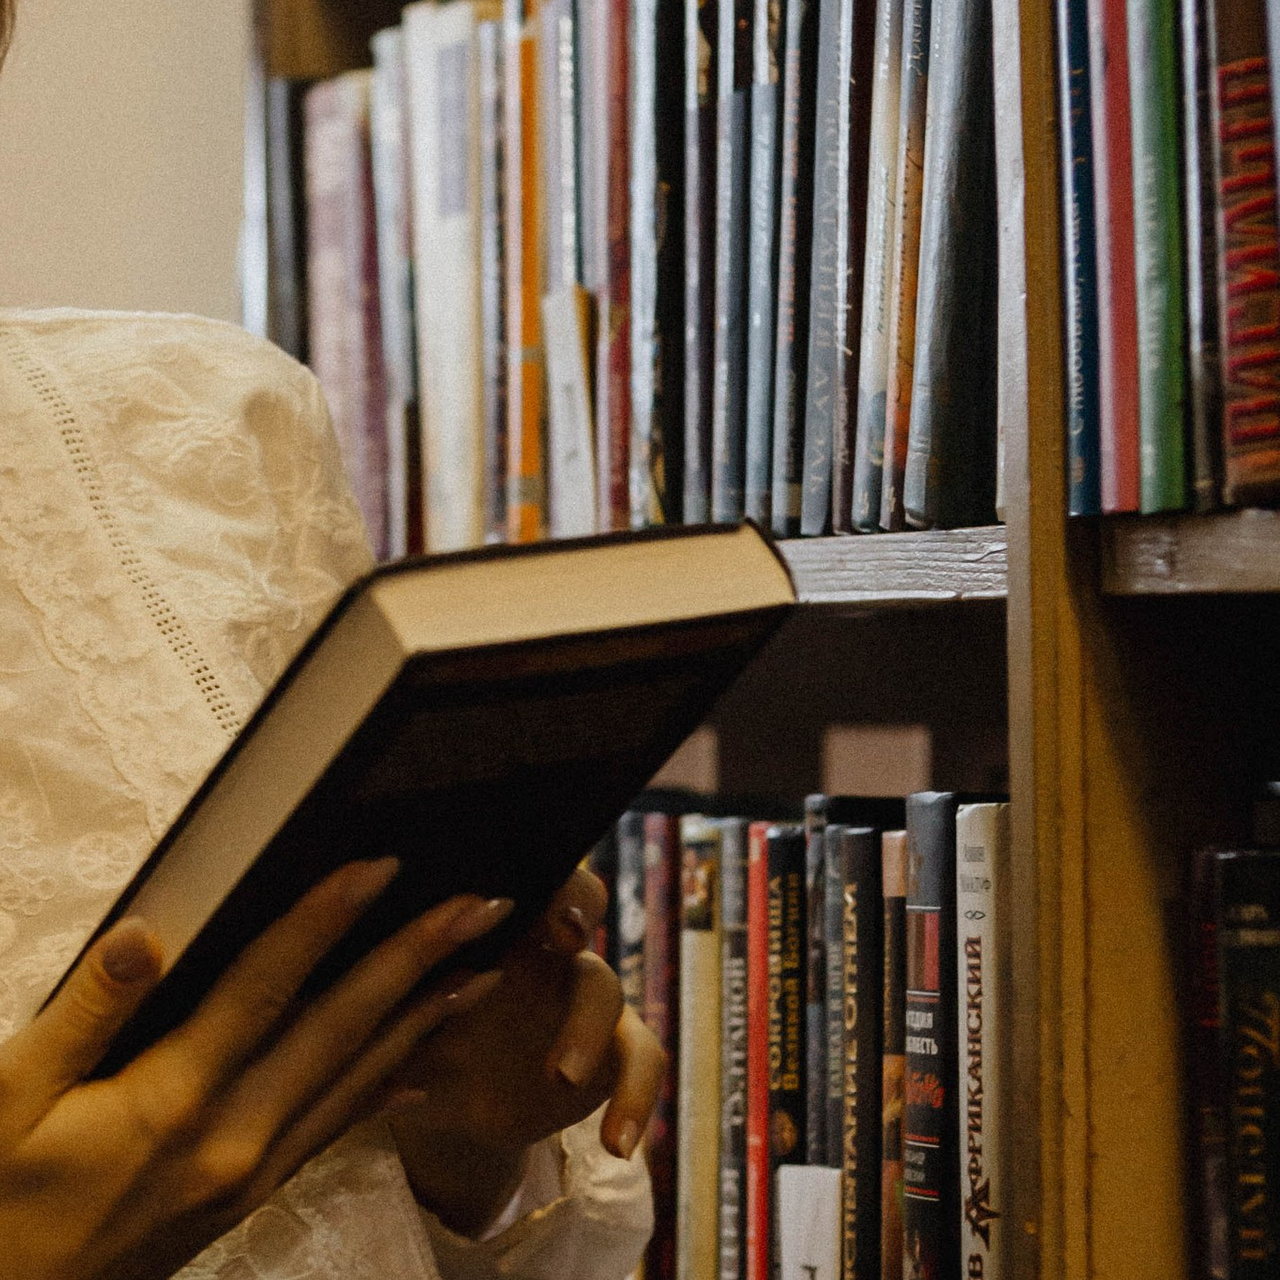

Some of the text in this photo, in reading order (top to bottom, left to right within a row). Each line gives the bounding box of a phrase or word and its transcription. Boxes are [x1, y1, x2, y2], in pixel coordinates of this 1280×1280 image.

[768, 875, 782, 1091] СОКРОВИЩА
[842, 882, 859, 1030] ОГНЕМ
[961, 935, 1001, 1251] АФРИКАНСКИЙ
